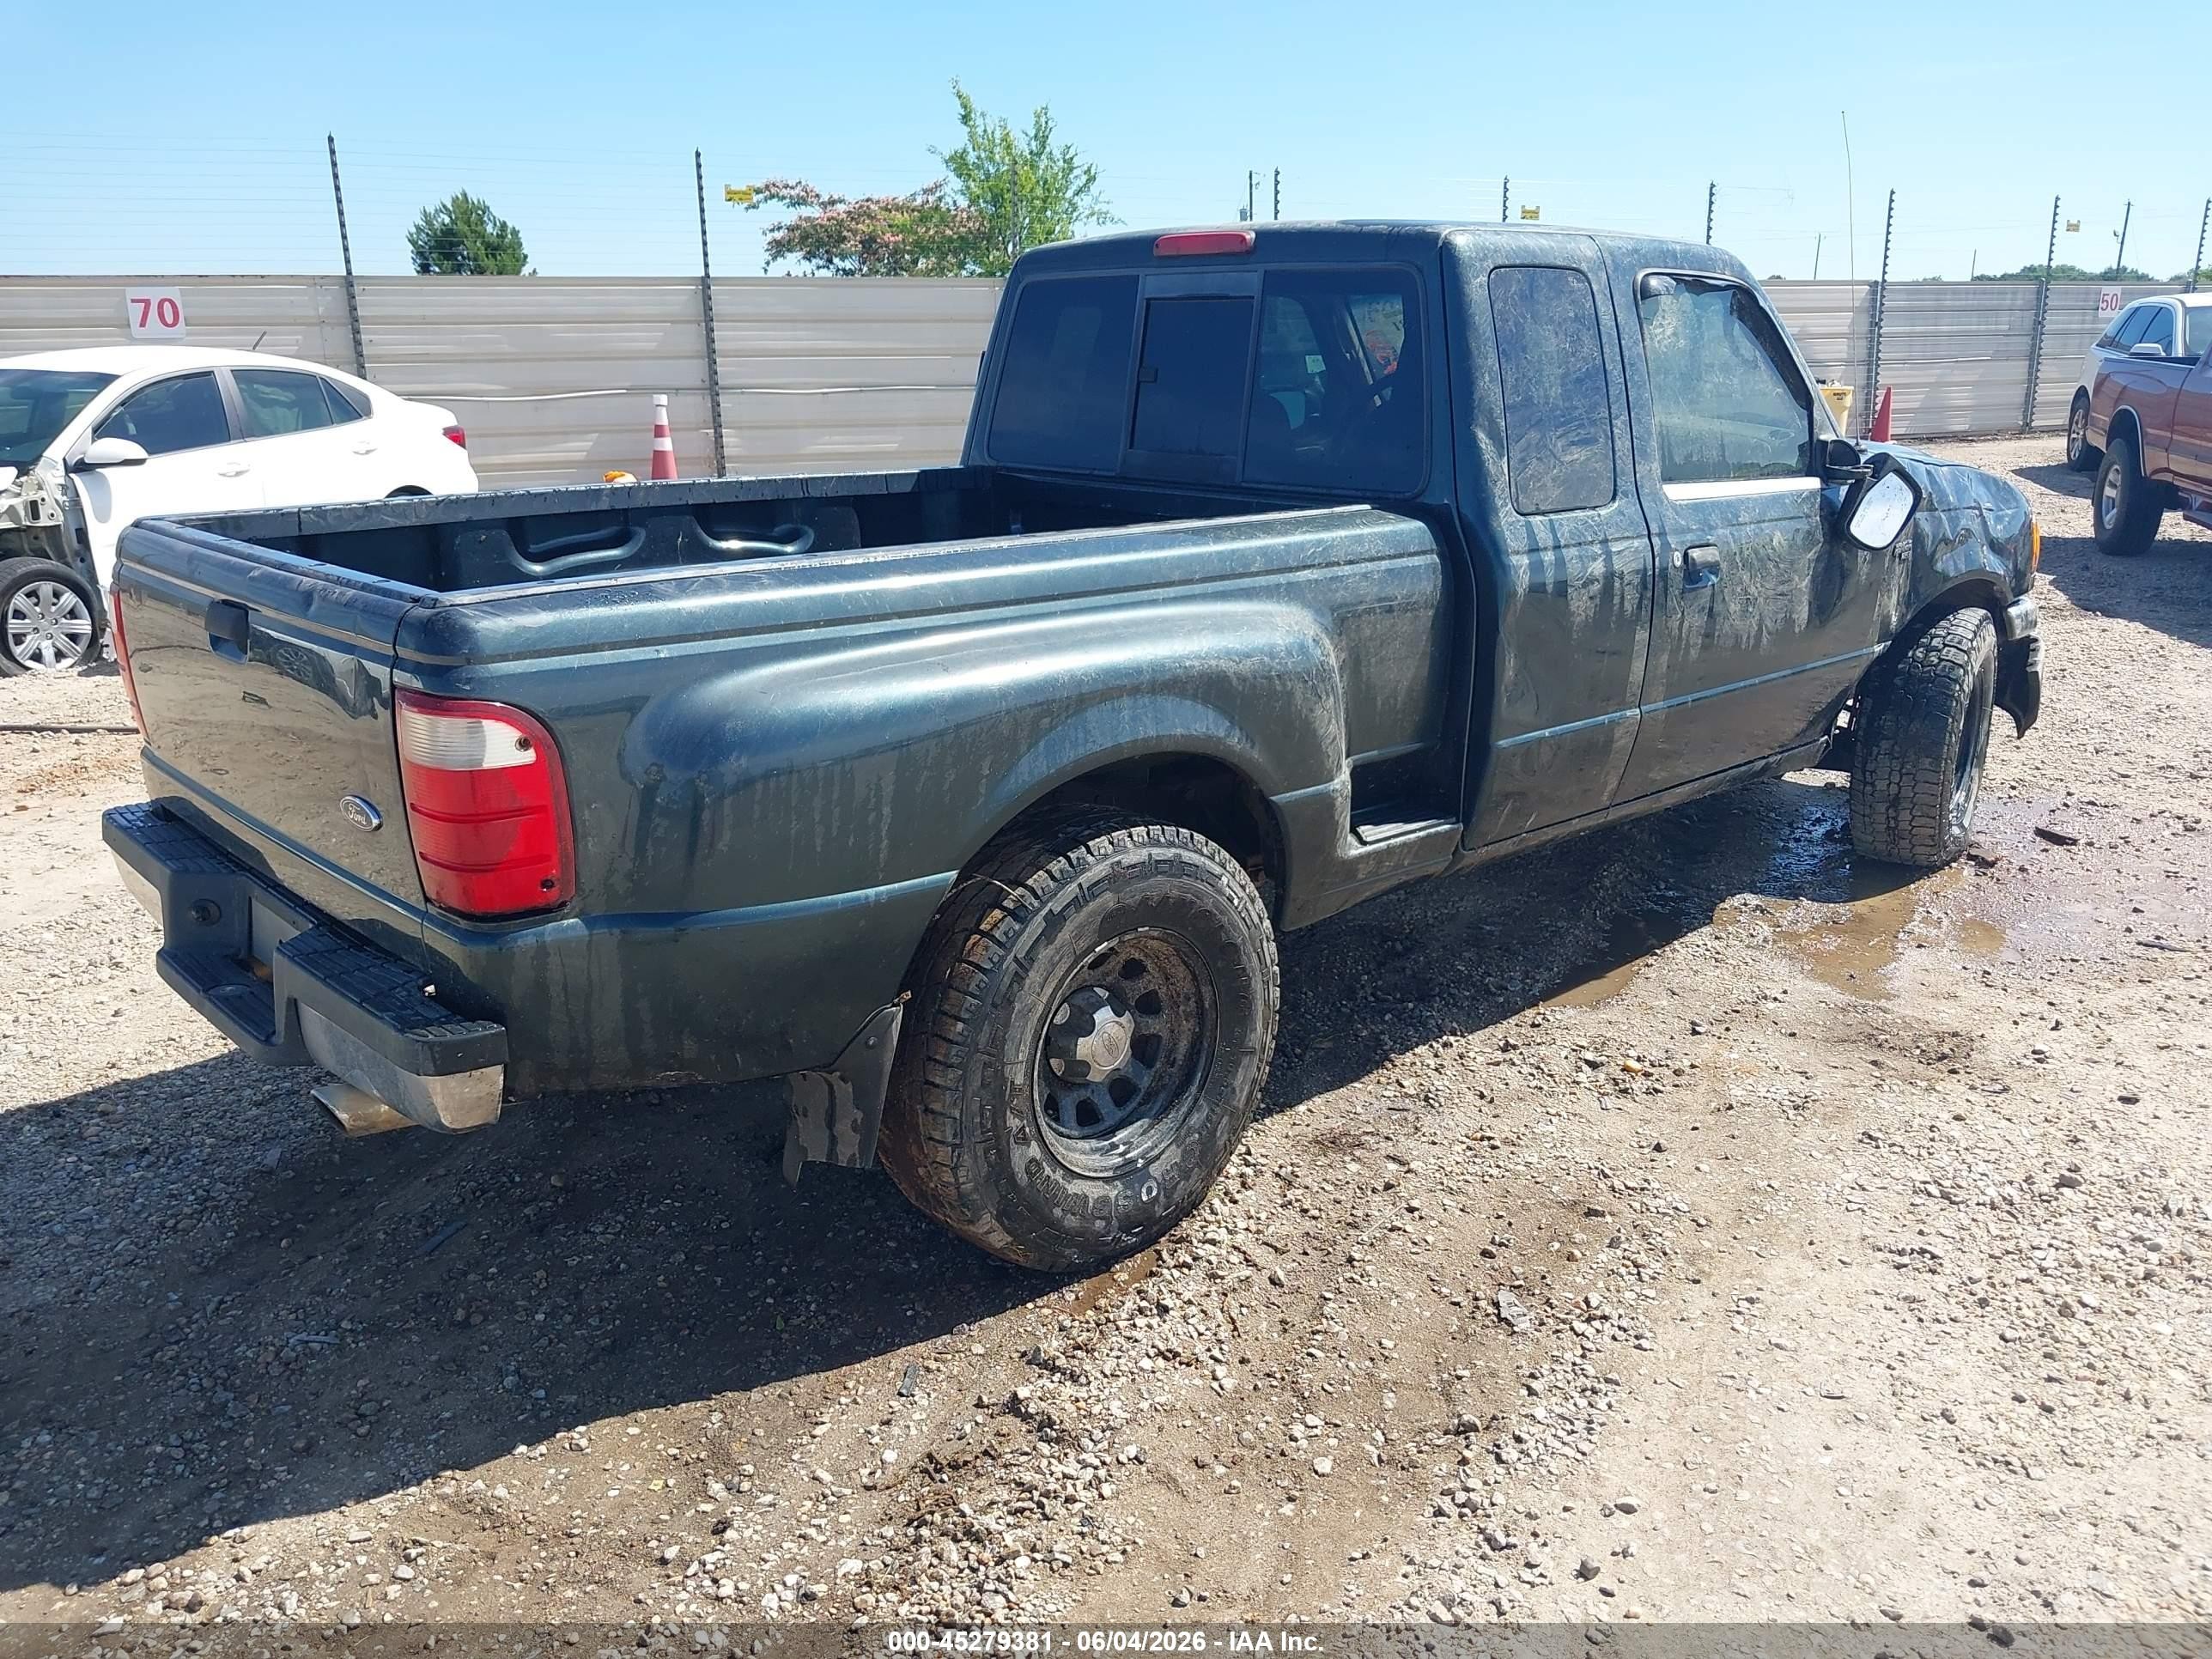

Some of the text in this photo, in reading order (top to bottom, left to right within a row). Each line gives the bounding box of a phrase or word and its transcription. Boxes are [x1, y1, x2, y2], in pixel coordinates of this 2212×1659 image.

[131, 297, 179, 328] 70
[2100, 293, 2119, 311] 50
[348, 804, 368, 825] Ford
[1024, 1139, 1203, 1218] CROSSWIND
